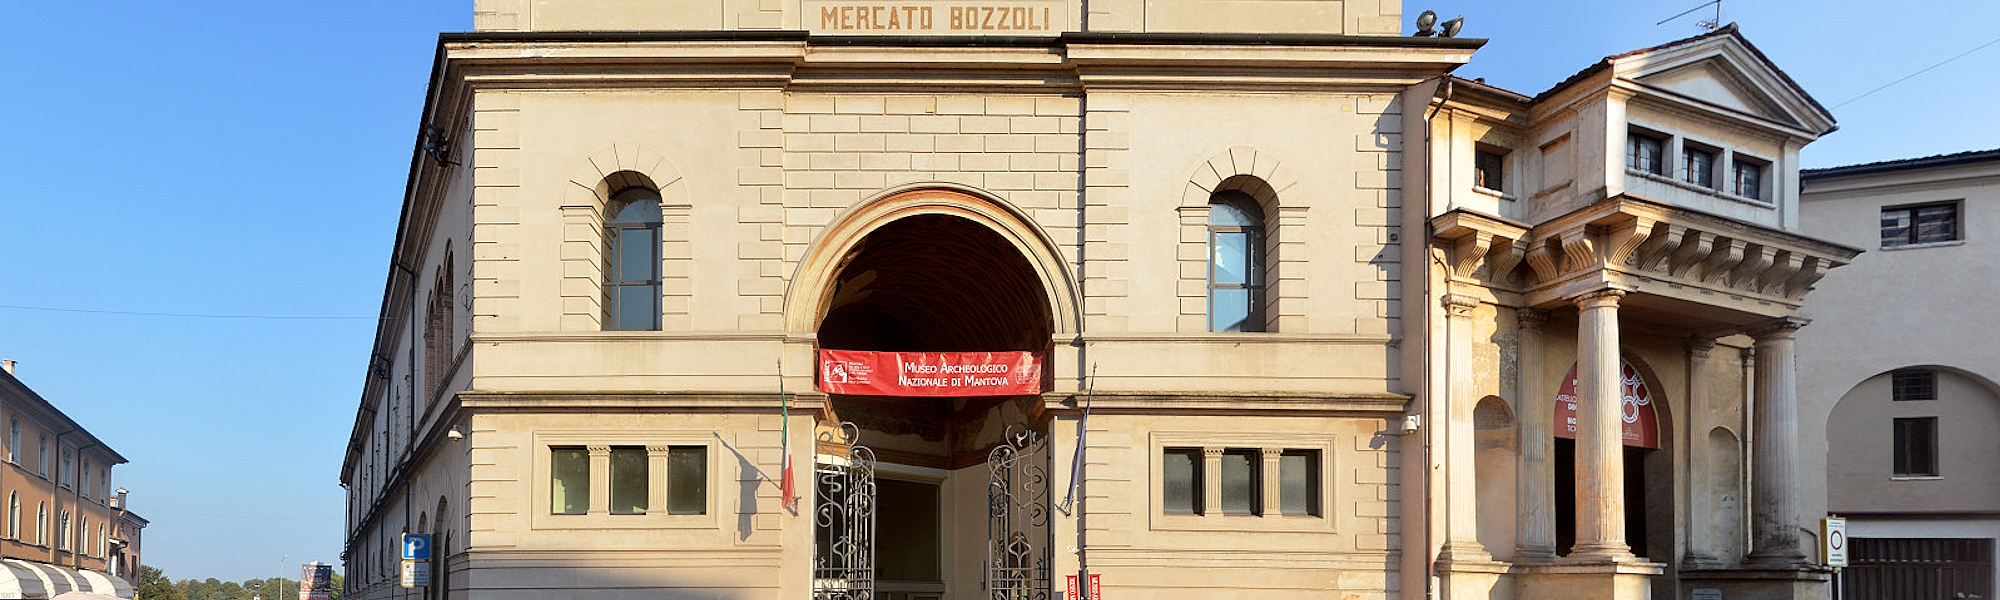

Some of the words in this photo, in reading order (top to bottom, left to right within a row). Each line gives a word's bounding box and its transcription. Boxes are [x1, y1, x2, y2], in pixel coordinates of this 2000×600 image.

[821, 6, 933, 30] MERCATO
[950, 6, 1050, 30] BOZZOLI
[904, 362, 937, 374] MUSEO
[898, 374, 948, 387] NAZIONALE
[964, 375, 1009, 387] MANTOVA
[408, 537, 425, 556] P
